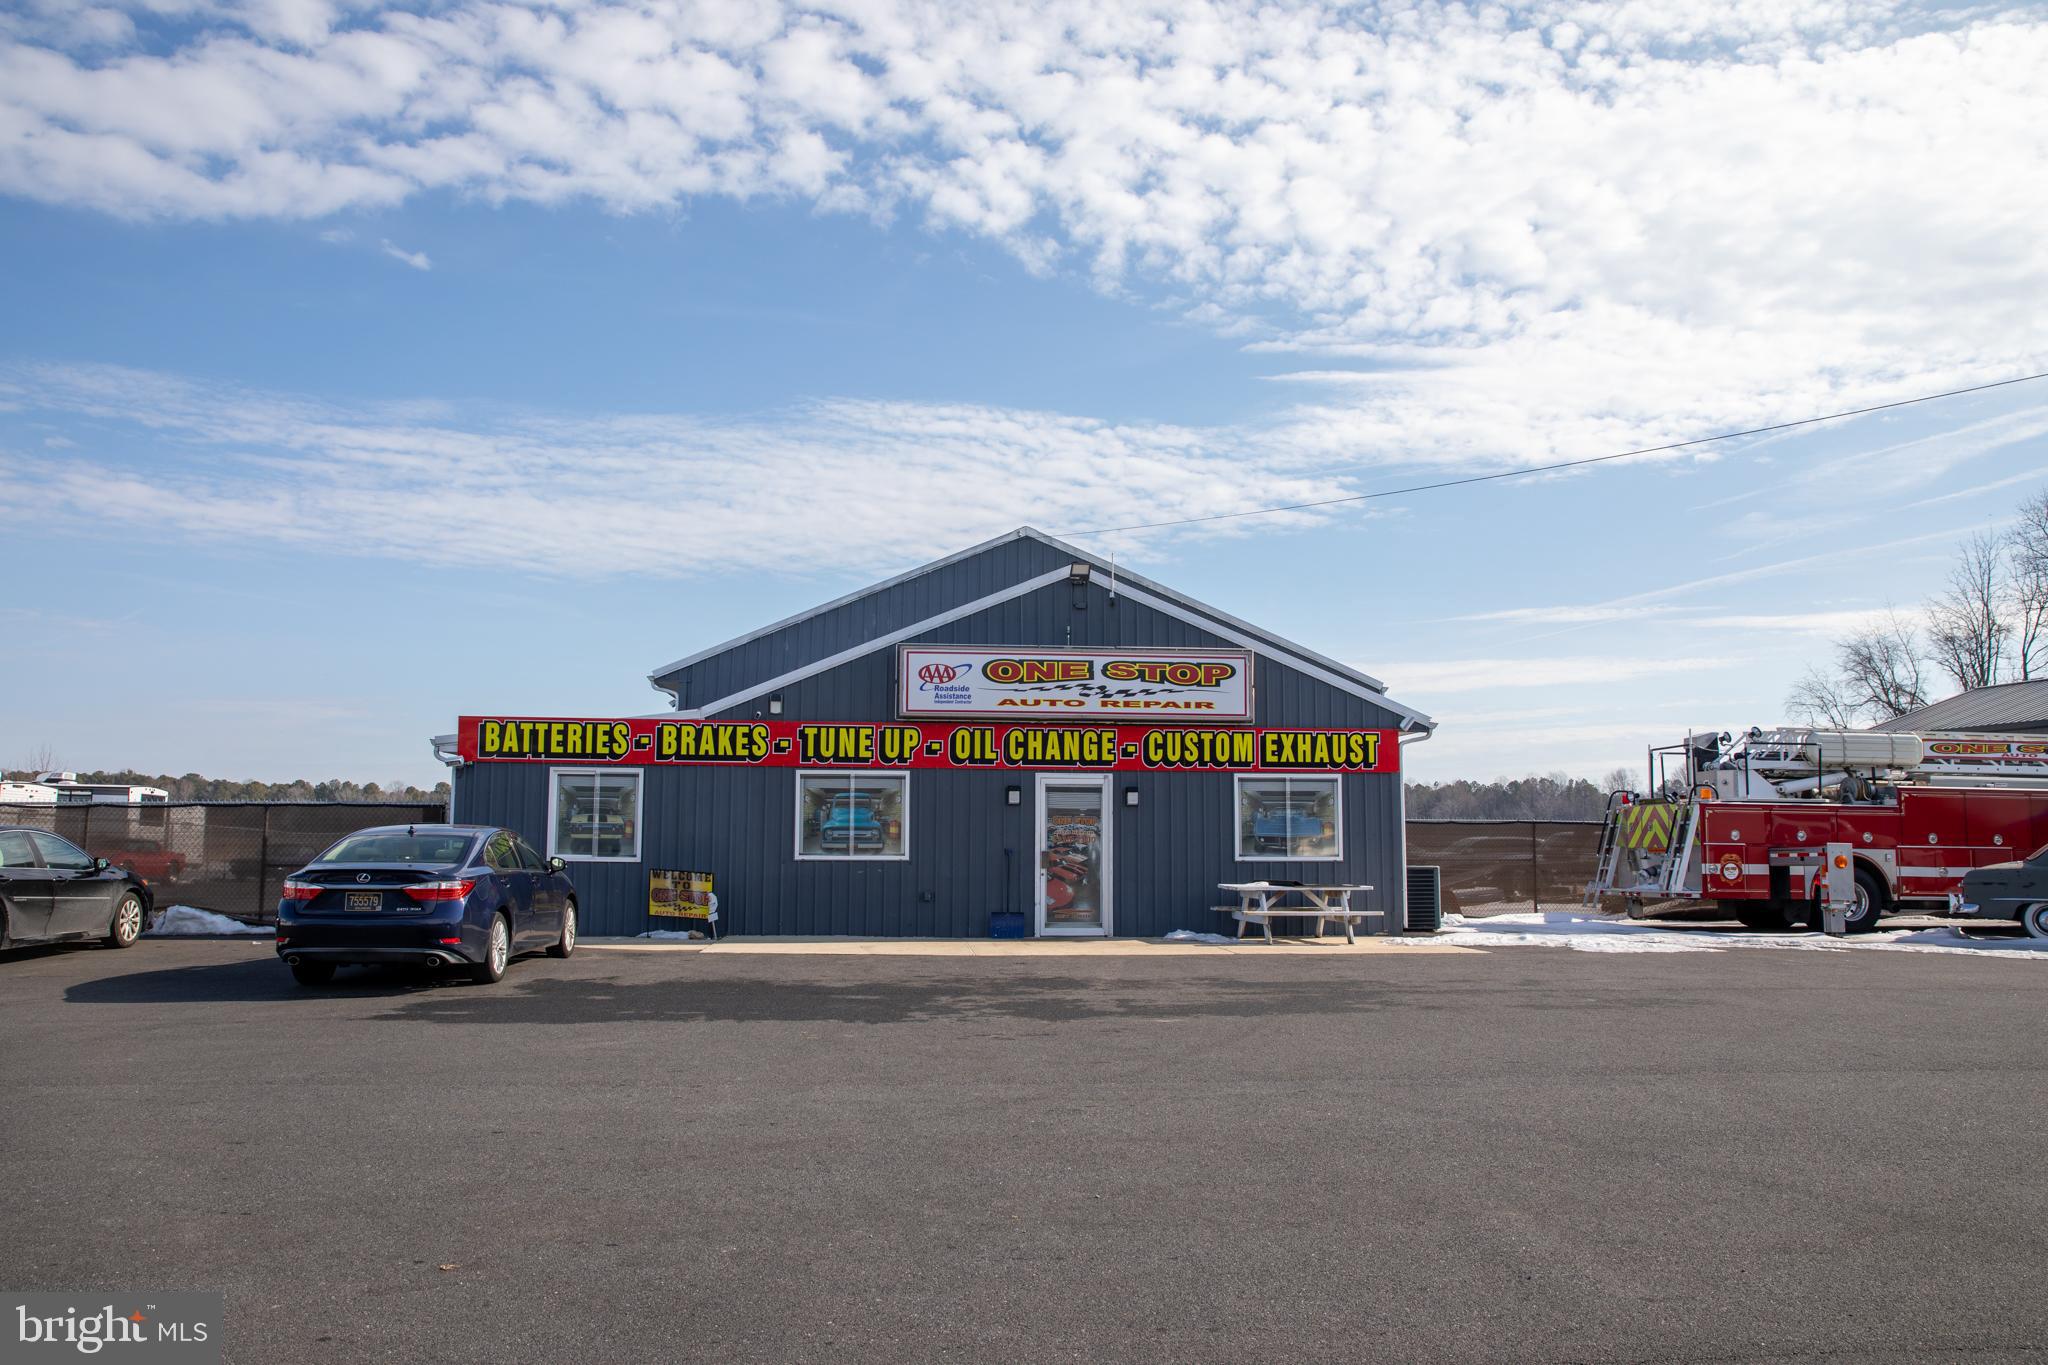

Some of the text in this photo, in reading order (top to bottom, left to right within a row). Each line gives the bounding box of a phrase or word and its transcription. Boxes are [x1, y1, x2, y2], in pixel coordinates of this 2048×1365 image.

[920, 664, 953, 684] AAA
[985, 660, 1233, 686] ONE STOP
[934, 692, 972, 700] Assistance
[998, 698, 1214, 709] AUTO REPAIR
[483, 722, 629, 757] BATTERIES
[660, 724, 768, 758] BRAKES
[803, 727, 873, 760] TUNE
[883, 728, 920, 760] UP
[953, 729, 998, 762] OIL
[1007, 730, 1116, 763] CHANGE
[1147, 731, 1254, 764] CUSTOM
[1263, 733, 1379, 765] EXHAUST
[1931, 744, 2010, 753] ONE
[652, 870, 712, 882] WELCOME
[672, 881, 691, 889] TO
[350, 895, 379, 906] 755579
